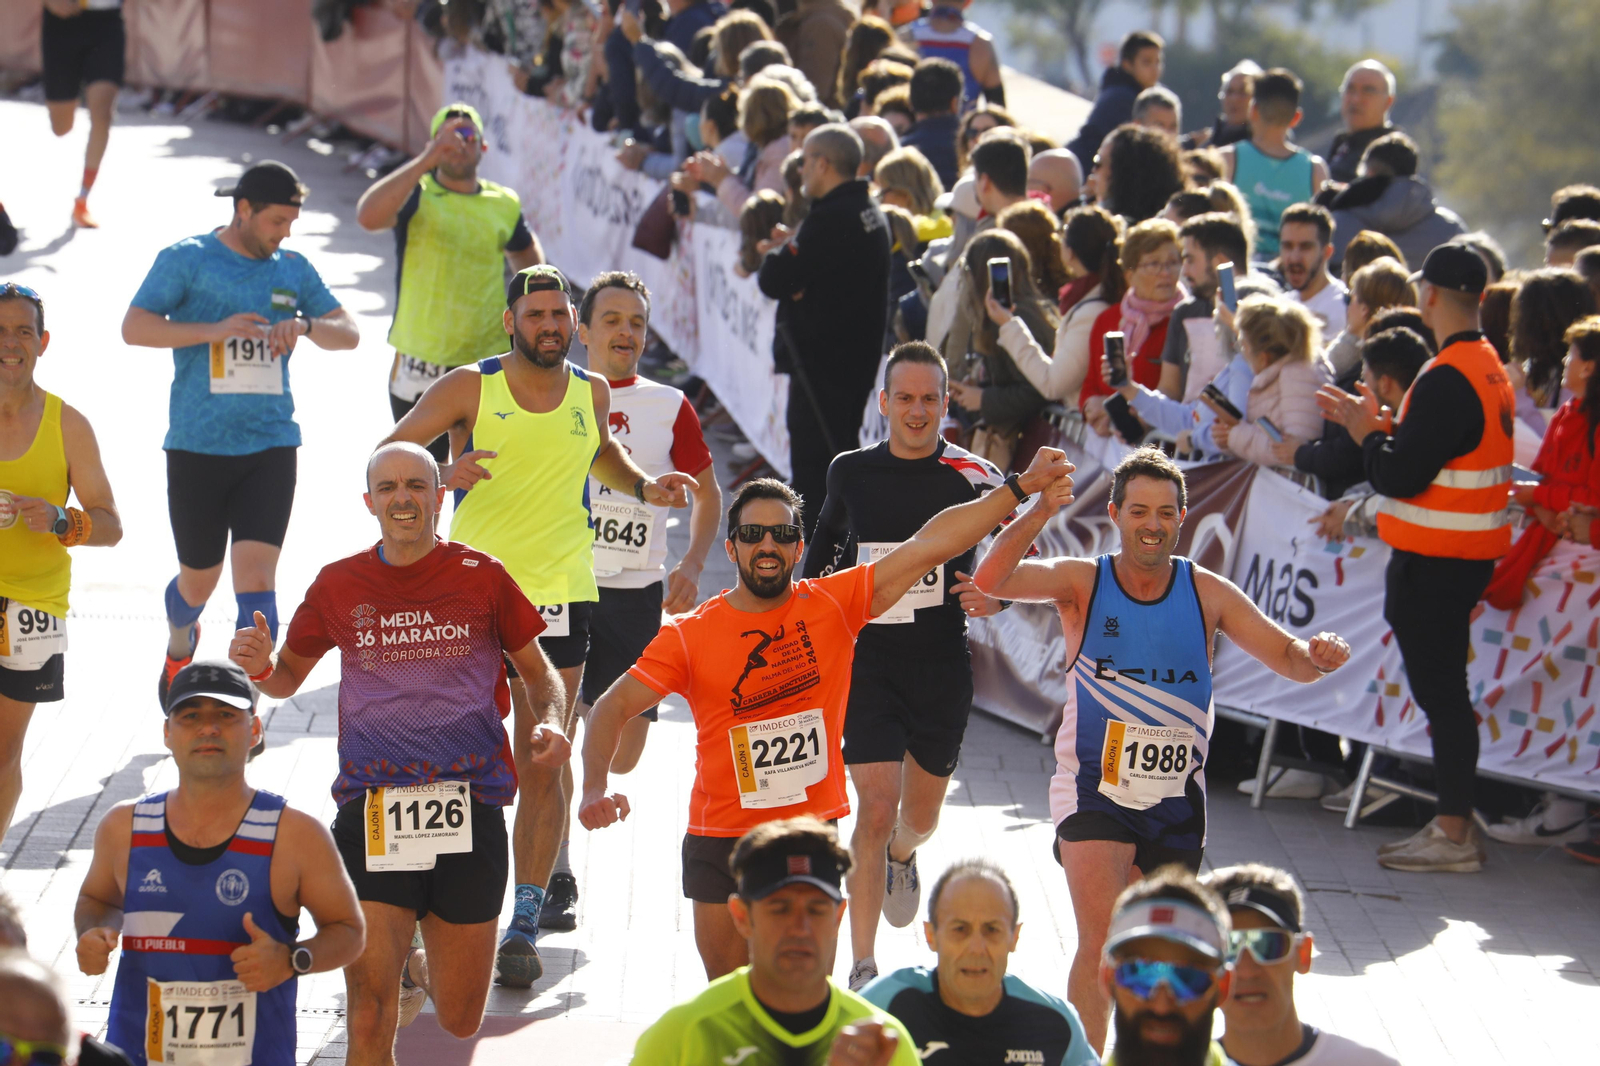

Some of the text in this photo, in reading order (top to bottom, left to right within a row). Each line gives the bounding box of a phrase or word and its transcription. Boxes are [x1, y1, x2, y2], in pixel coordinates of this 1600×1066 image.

[600, 504, 631, 514] IMDECO
[594, 516, 648, 548] 4643
[380, 610, 434, 628] MEDIA
[355, 621, 470, 648] 36 MARATÓN
[382, 644, 471, 662] CÓRDOBA 2022
[772, 640, 799, 654] CIUDAD
[771, 654, 804, 668] NARANJA
[762, 671, 782, 682] PALMA
[795, 662, 806, 670] RÍO
[742, 688, 778, 706] CARRERA
[778, 670, 818, 690] NOCTURNA
[760, 718, 796, 732] IMDECO
[1138, 728, 1172, 738] IMDECO
[752, 727, 820, 768] 2221
[1124, 741, 1187, 773] 1988
[739, 750, 750, 778] CAJÓN
[777, 763, 804, 774] VILLANUEVA
[1108, 746, 1117, 772] CAJÓN
[396, 784, 436, 793] IMDECO
[388, 799, 464, 831] 1126
[144, 938, 186, 952] PUEBLA
[176, 986, 219, 997] IMDECO
[152, 1010, 160, 1044] CAJÓN
[166, 1002, 244, 1039] 1771
